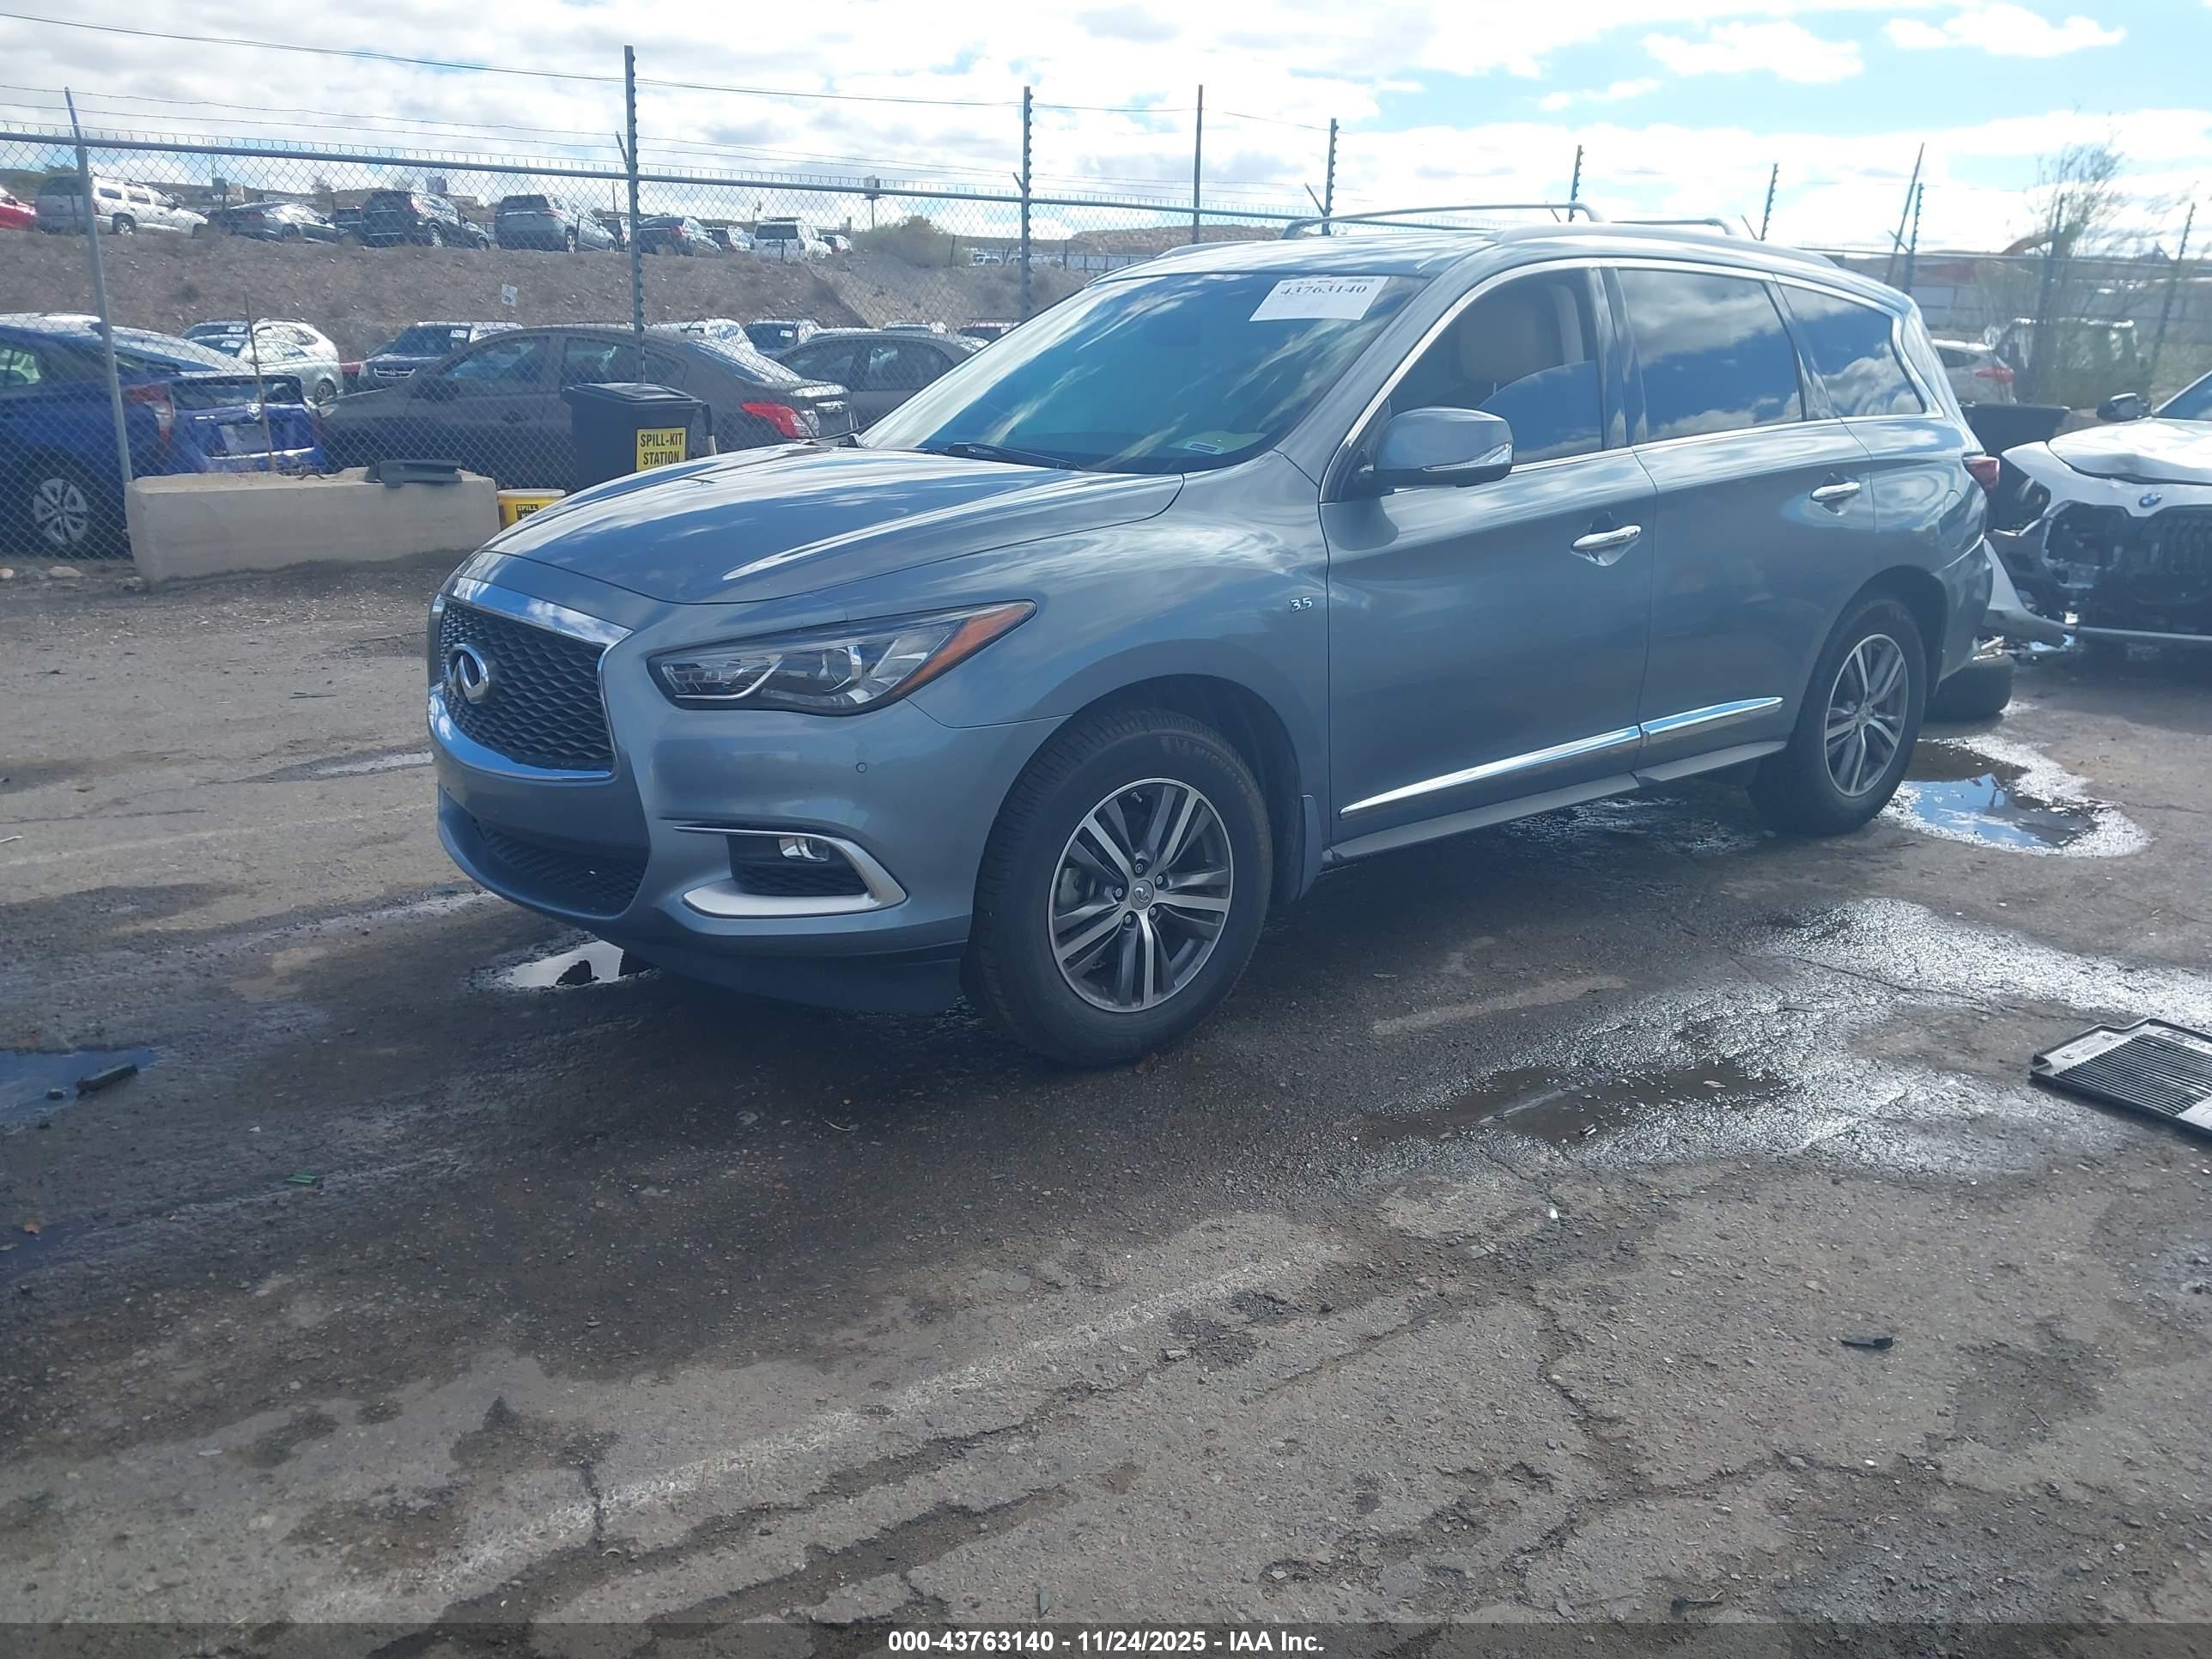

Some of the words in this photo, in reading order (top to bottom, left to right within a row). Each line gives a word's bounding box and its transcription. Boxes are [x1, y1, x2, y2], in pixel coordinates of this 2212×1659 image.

[1281, 285, 1367, 295] 43763140
[640, 433, 684, 447] SPILL-KIT
[643, 451, 679, 465] STATION
